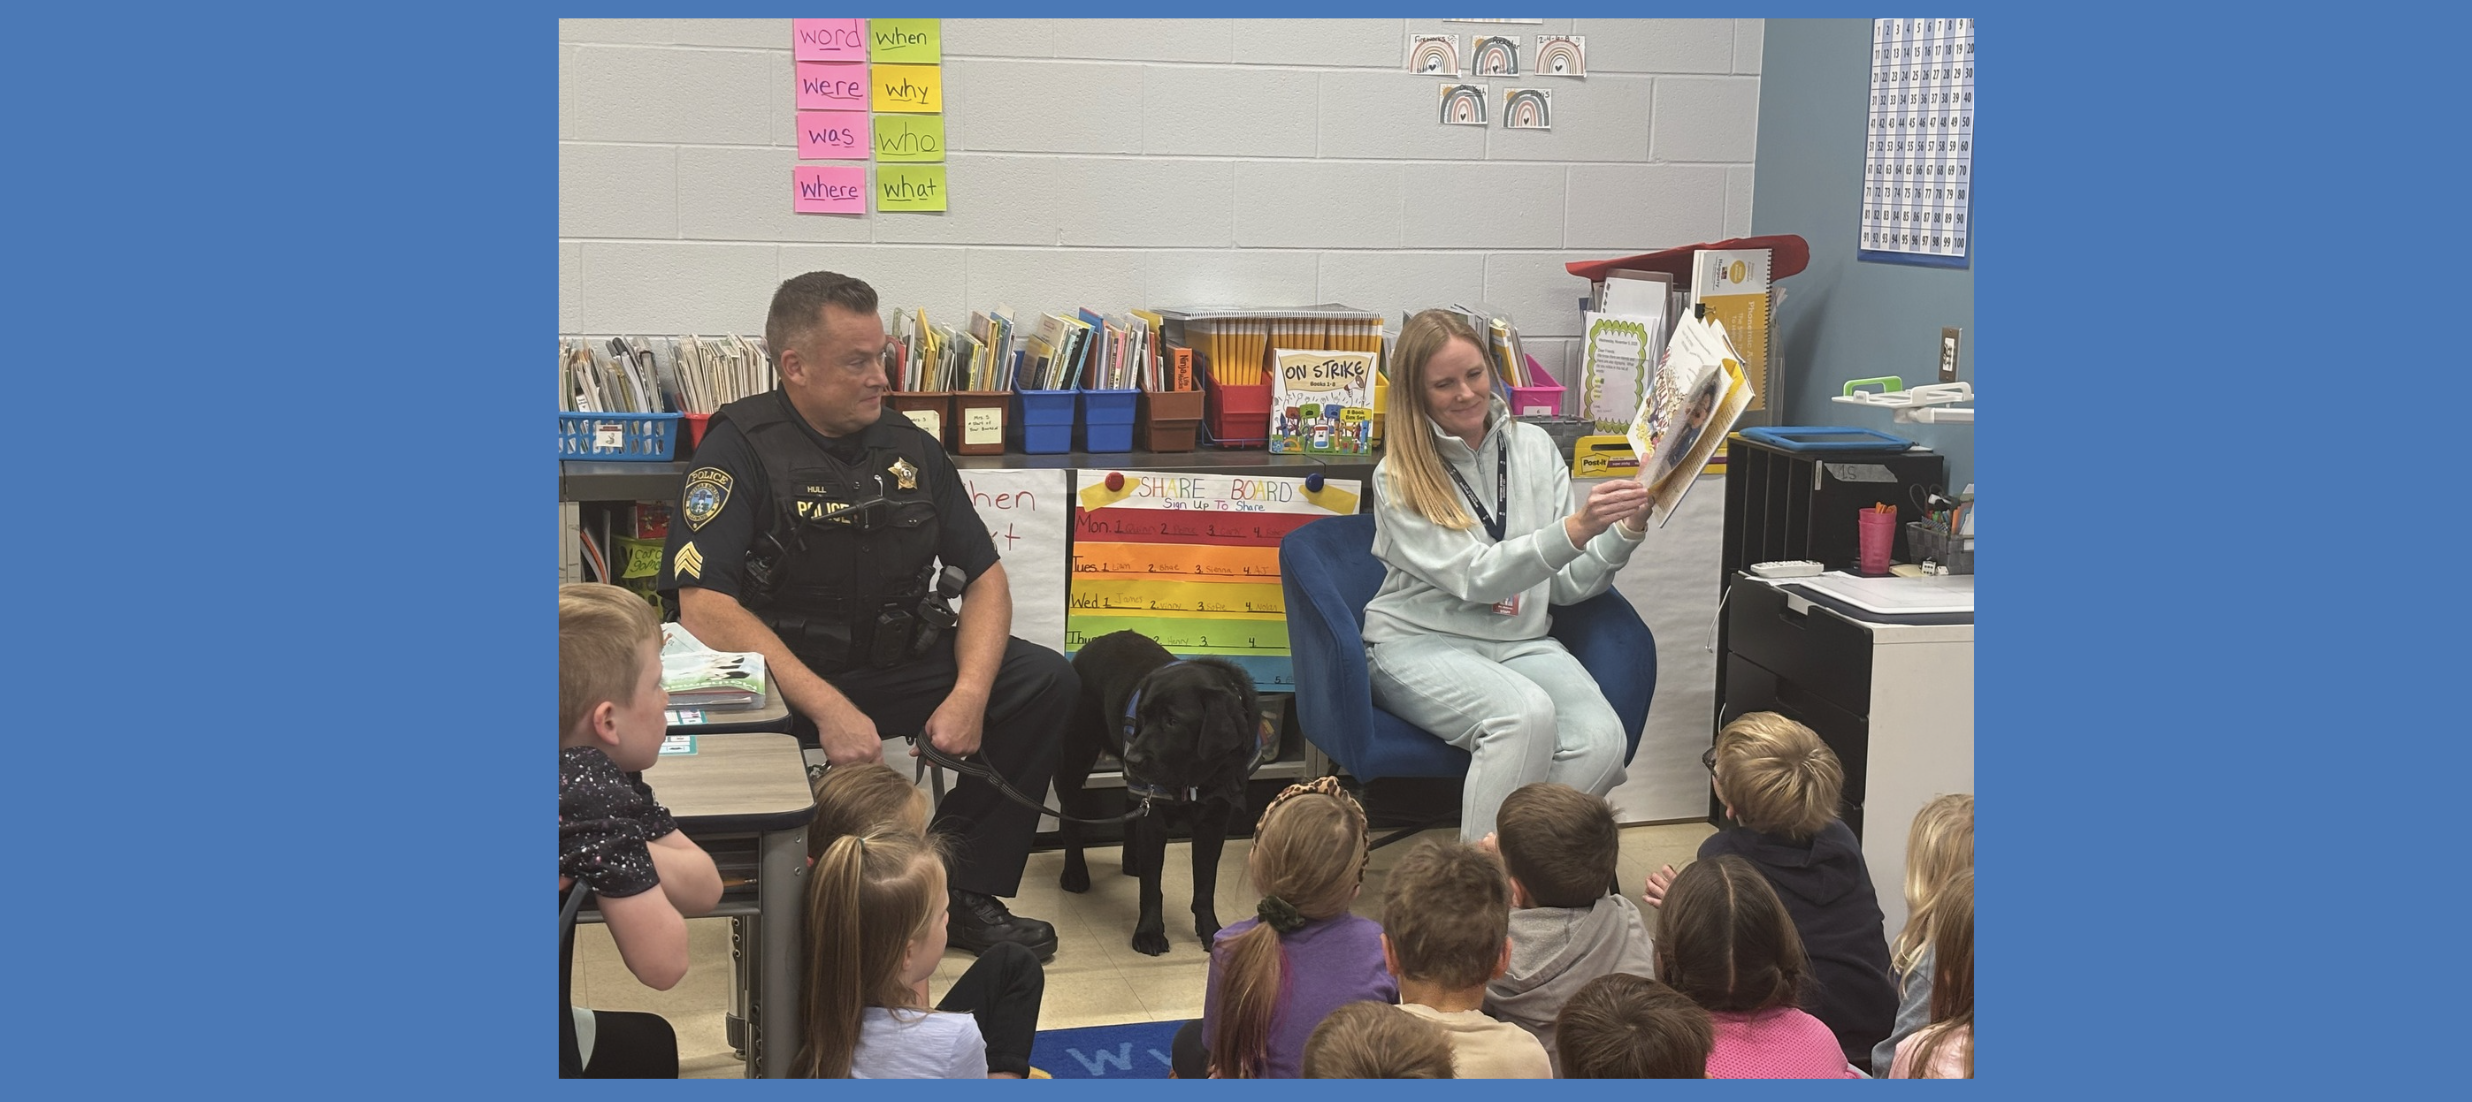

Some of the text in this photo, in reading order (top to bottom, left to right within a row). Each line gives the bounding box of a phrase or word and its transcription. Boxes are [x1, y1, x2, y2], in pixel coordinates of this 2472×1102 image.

[800, 18, 861, 48] word
[876, 27, 927, 45] when
[1878, 26, 1881, 36] 1
[1886, 25, 1889, 35] 2
[1896, 24, 1900, 35] 3
[1906, 24, 1910, 33] 4
[1917, 23, 1921, 33] 5
[1928, 22, 1931, 32] 6
[1938, 21, 1942, 31] 7
[1948, 20, 1952, 30] 8
[1960, 19, 1963, 30] 9
[1875, 43, 1974, 59] 11 12 13 14 15 16 17 18 19 20
[1873, 68, 1973, 83] 21 22 23 24 25 26 27 28 29 30
[803, 78, 863, 97] were
[885, 78, 928, 104] why
[1872, 92, 1972, 106] 31 32 33 34 35 36 37 38 39 40
[1871, 117, 1970, 128] 41 42 43 44 45 46 47 48 49 50
[809, 128, 854, 145] was
[879, 121, 936, 152] who
[1869, 141, 1968, 152] 51 52 53 54 55 56 57 58 59 60
[801, 175, 858, 198] where
[884, 175, 936, 198] what
[1866, 187, 1965, 200] 71 72 73 74 75 76 77 78 79 80
[1864, 232, 1964, 248] 91 92 93 94 95 96 97 98 99 100
[1285, 359, 1364, 380] ON STRIKE
[692, 471, 728, 484] POLICE
[969, 480, 1035, 511] hen
[1138, 476, 1293, 502] SHARE BOARD
[1163, 498, 1265, 512] Sign Up To Share
[1076, 513, 1112, 534] Mon.
[1114, 592, 1143, 604] James
[1168, 636, 1189, 646] Henry
[1066, 1042, 1134, 1076] W
